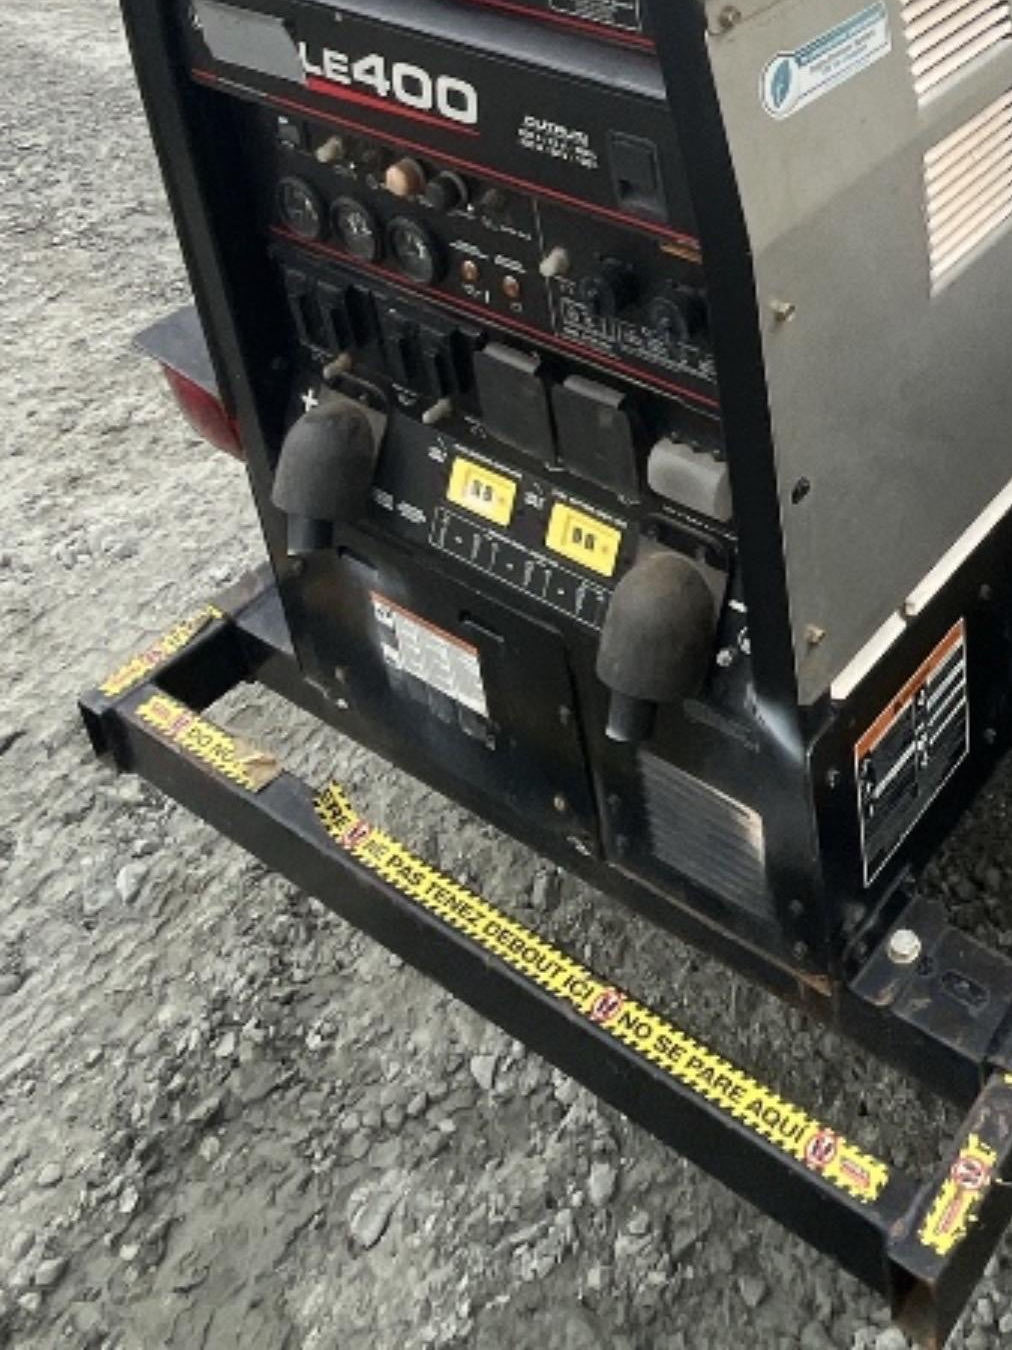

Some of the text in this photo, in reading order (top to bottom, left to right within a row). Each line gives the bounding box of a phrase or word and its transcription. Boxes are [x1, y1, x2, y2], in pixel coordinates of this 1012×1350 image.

[298, 40, 479, 125] LE400
[386, 853, 426, 887] PAS
[423, 878, 487, 927] TENEZ
[481, 920, 567, 980] DEBOUT
[562, 971, 596, 1001] ICI
[617, 1010, 653, 1040] NO
[652, 1034, 688, 1063] SE
[684, 1055, 749, 1104] PARE
